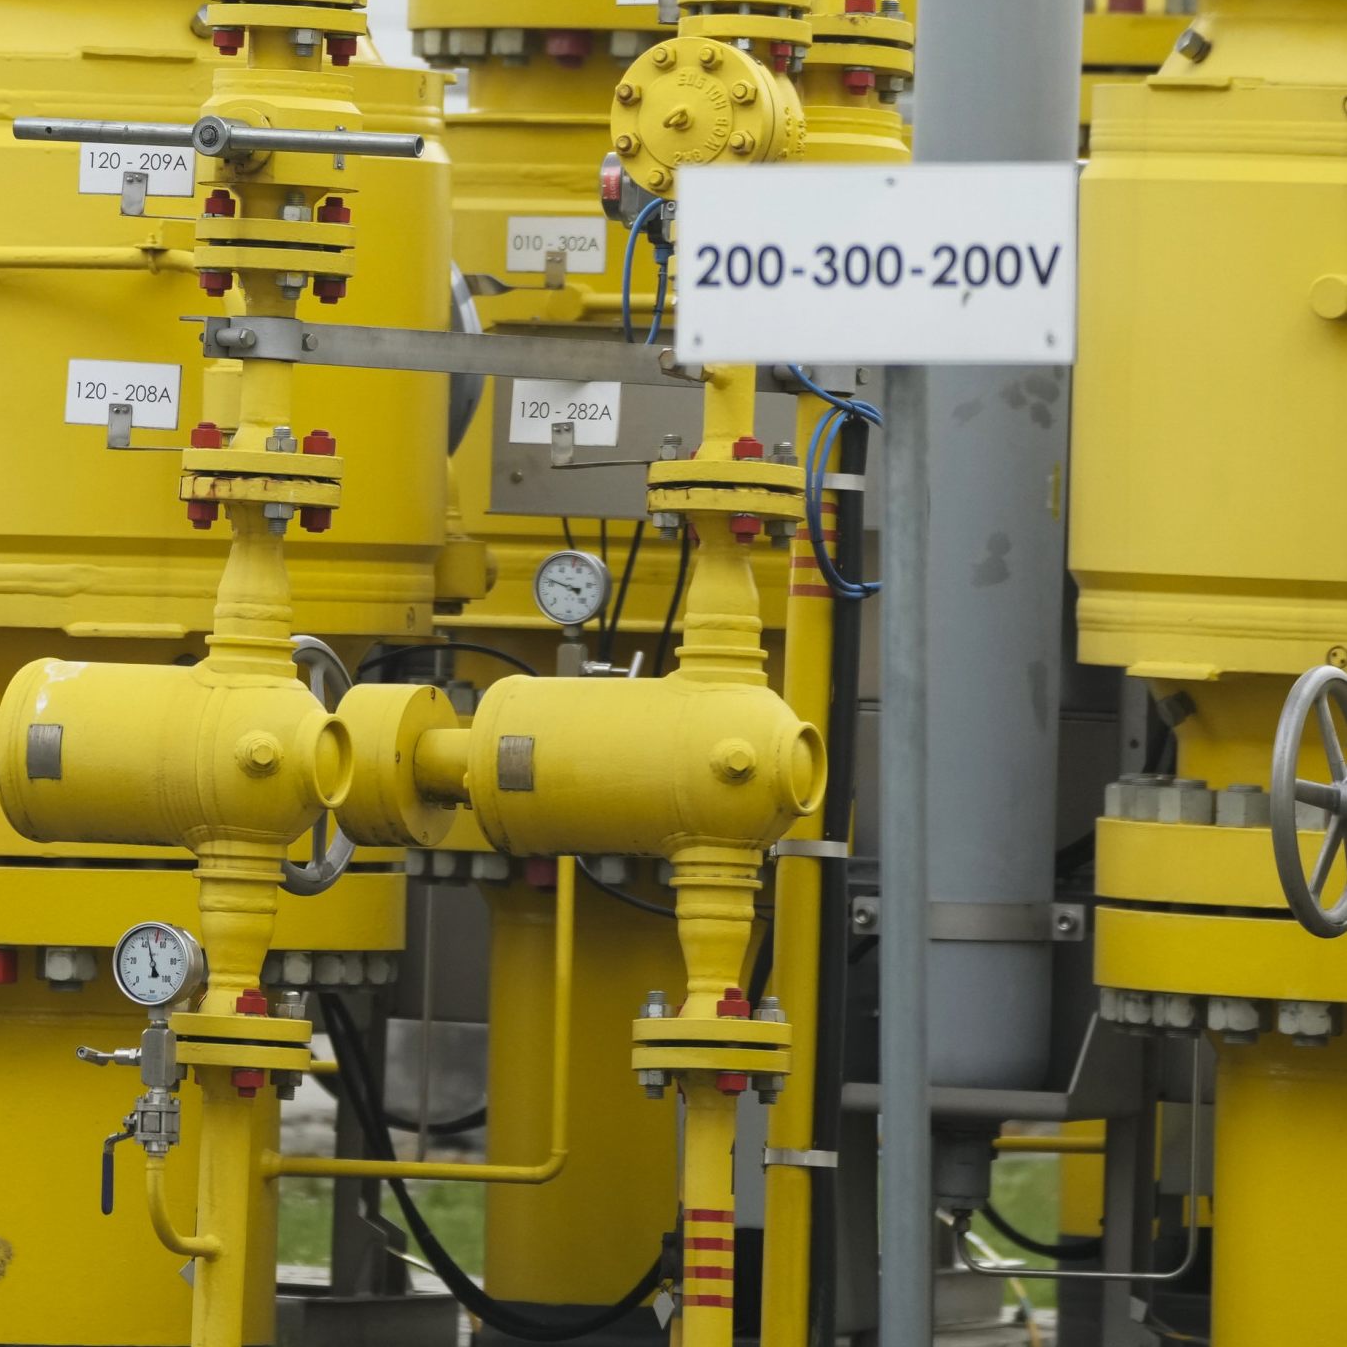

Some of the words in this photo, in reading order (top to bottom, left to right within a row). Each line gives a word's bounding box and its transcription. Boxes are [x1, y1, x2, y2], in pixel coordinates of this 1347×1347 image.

[89, 151, 121, 169] 120
[139, 153, 187, 171] 209A
[513, 235, 543, 251] 010
[558, 235, 599, 252] 302A
[695, 243, 1062, 289] 200-300-200V
[76, 381, 107, 400] 120
[125, 384, 172, 403] 208A
[520, 401, 550, 419] 120
[567, 402, 612, 421] 282A
[161, 975, 171, 983] 100
